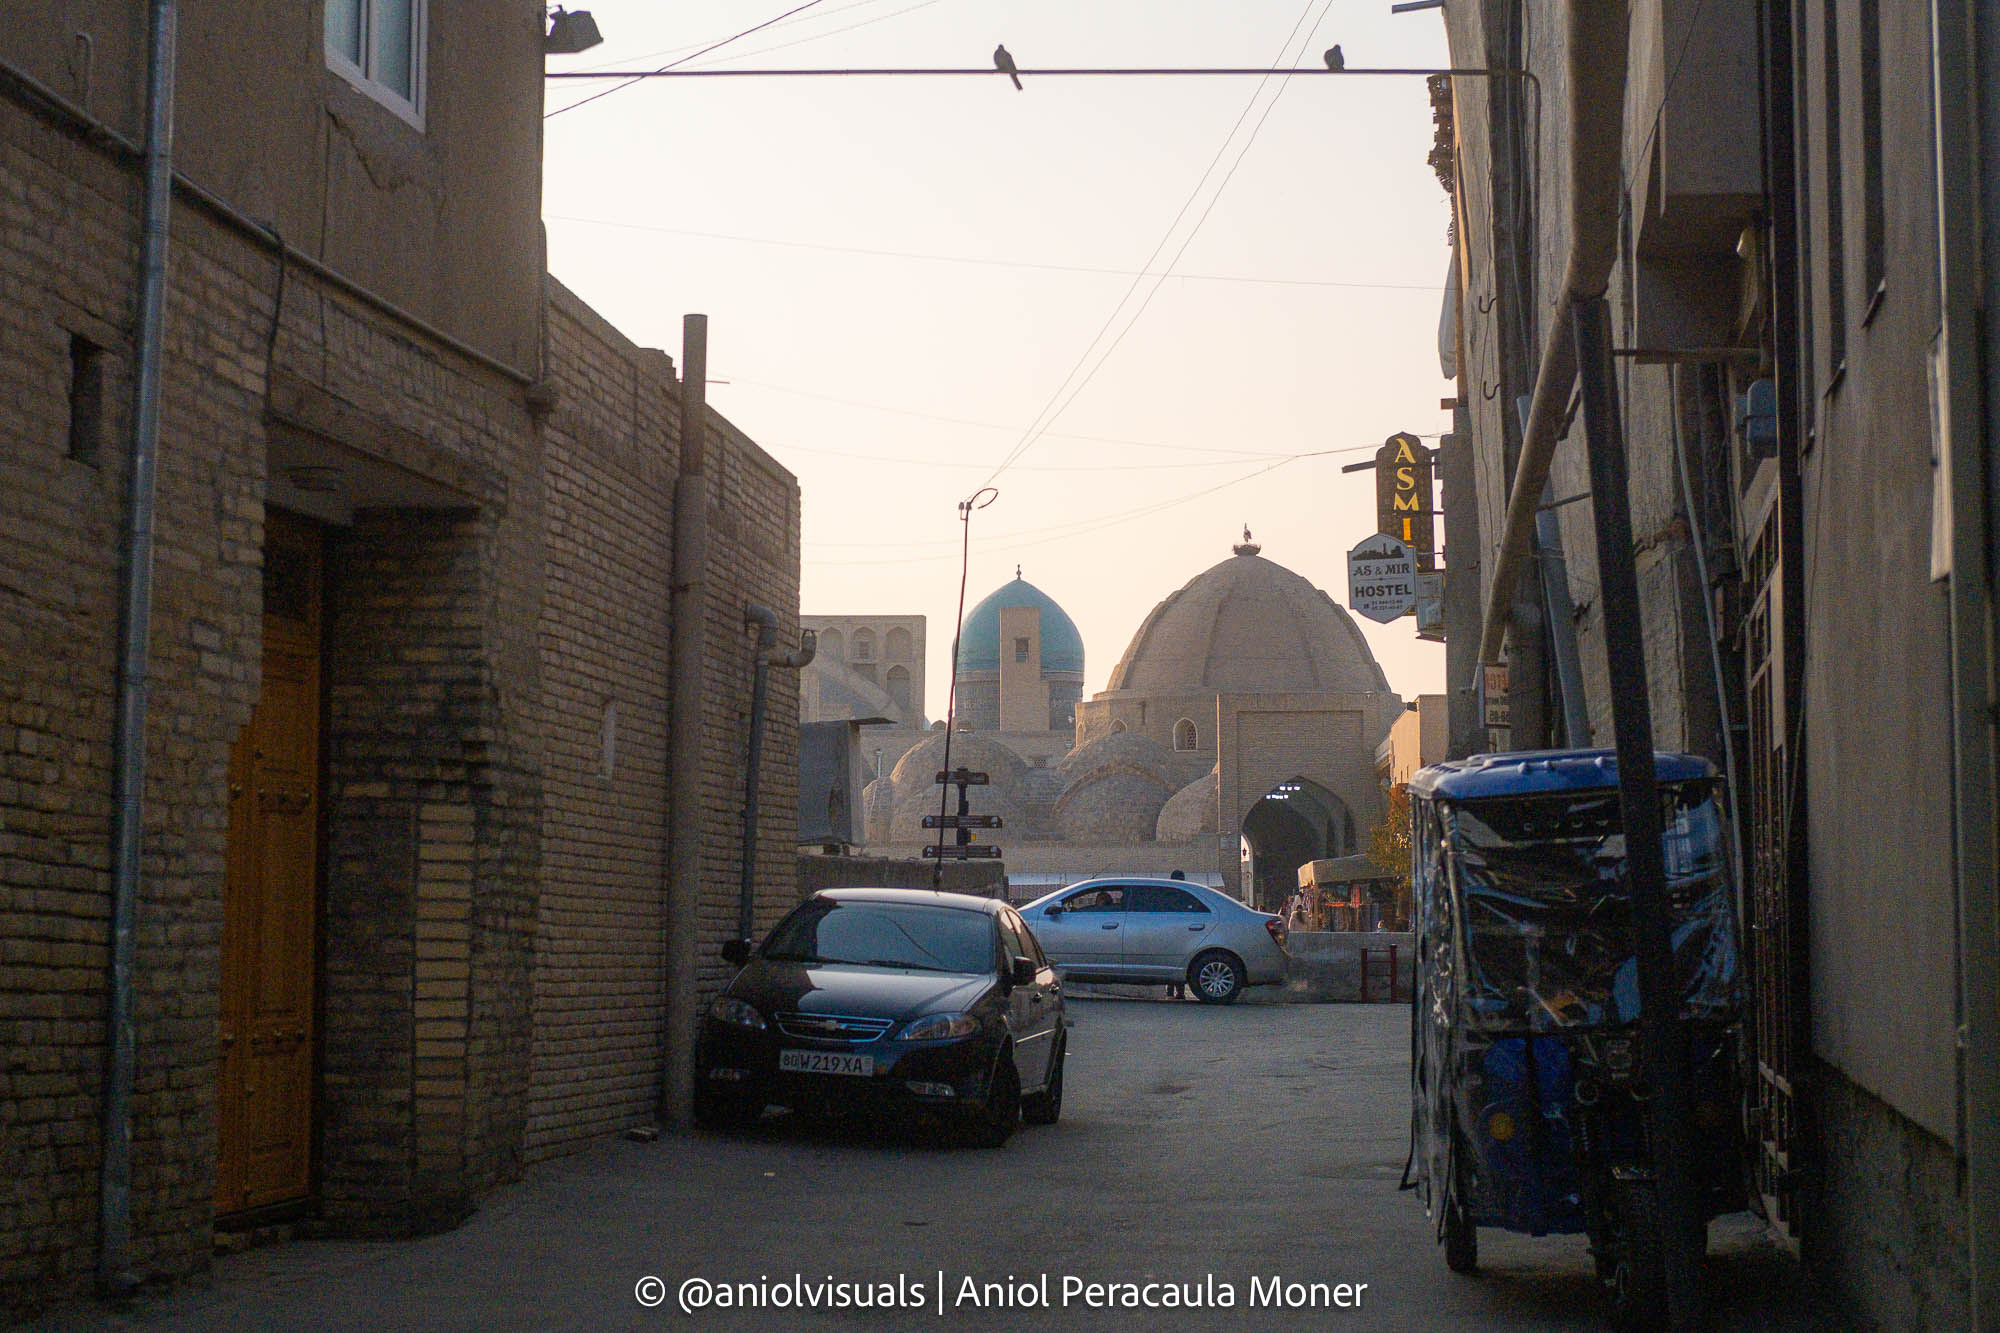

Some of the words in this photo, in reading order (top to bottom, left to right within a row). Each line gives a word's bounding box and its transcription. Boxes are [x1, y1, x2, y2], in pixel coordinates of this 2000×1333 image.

[1353, 564, 1371, 577] AS
[1385, 563, 1410, 575] MIR
[1354, 583, 1413, 598] HOSTEL
